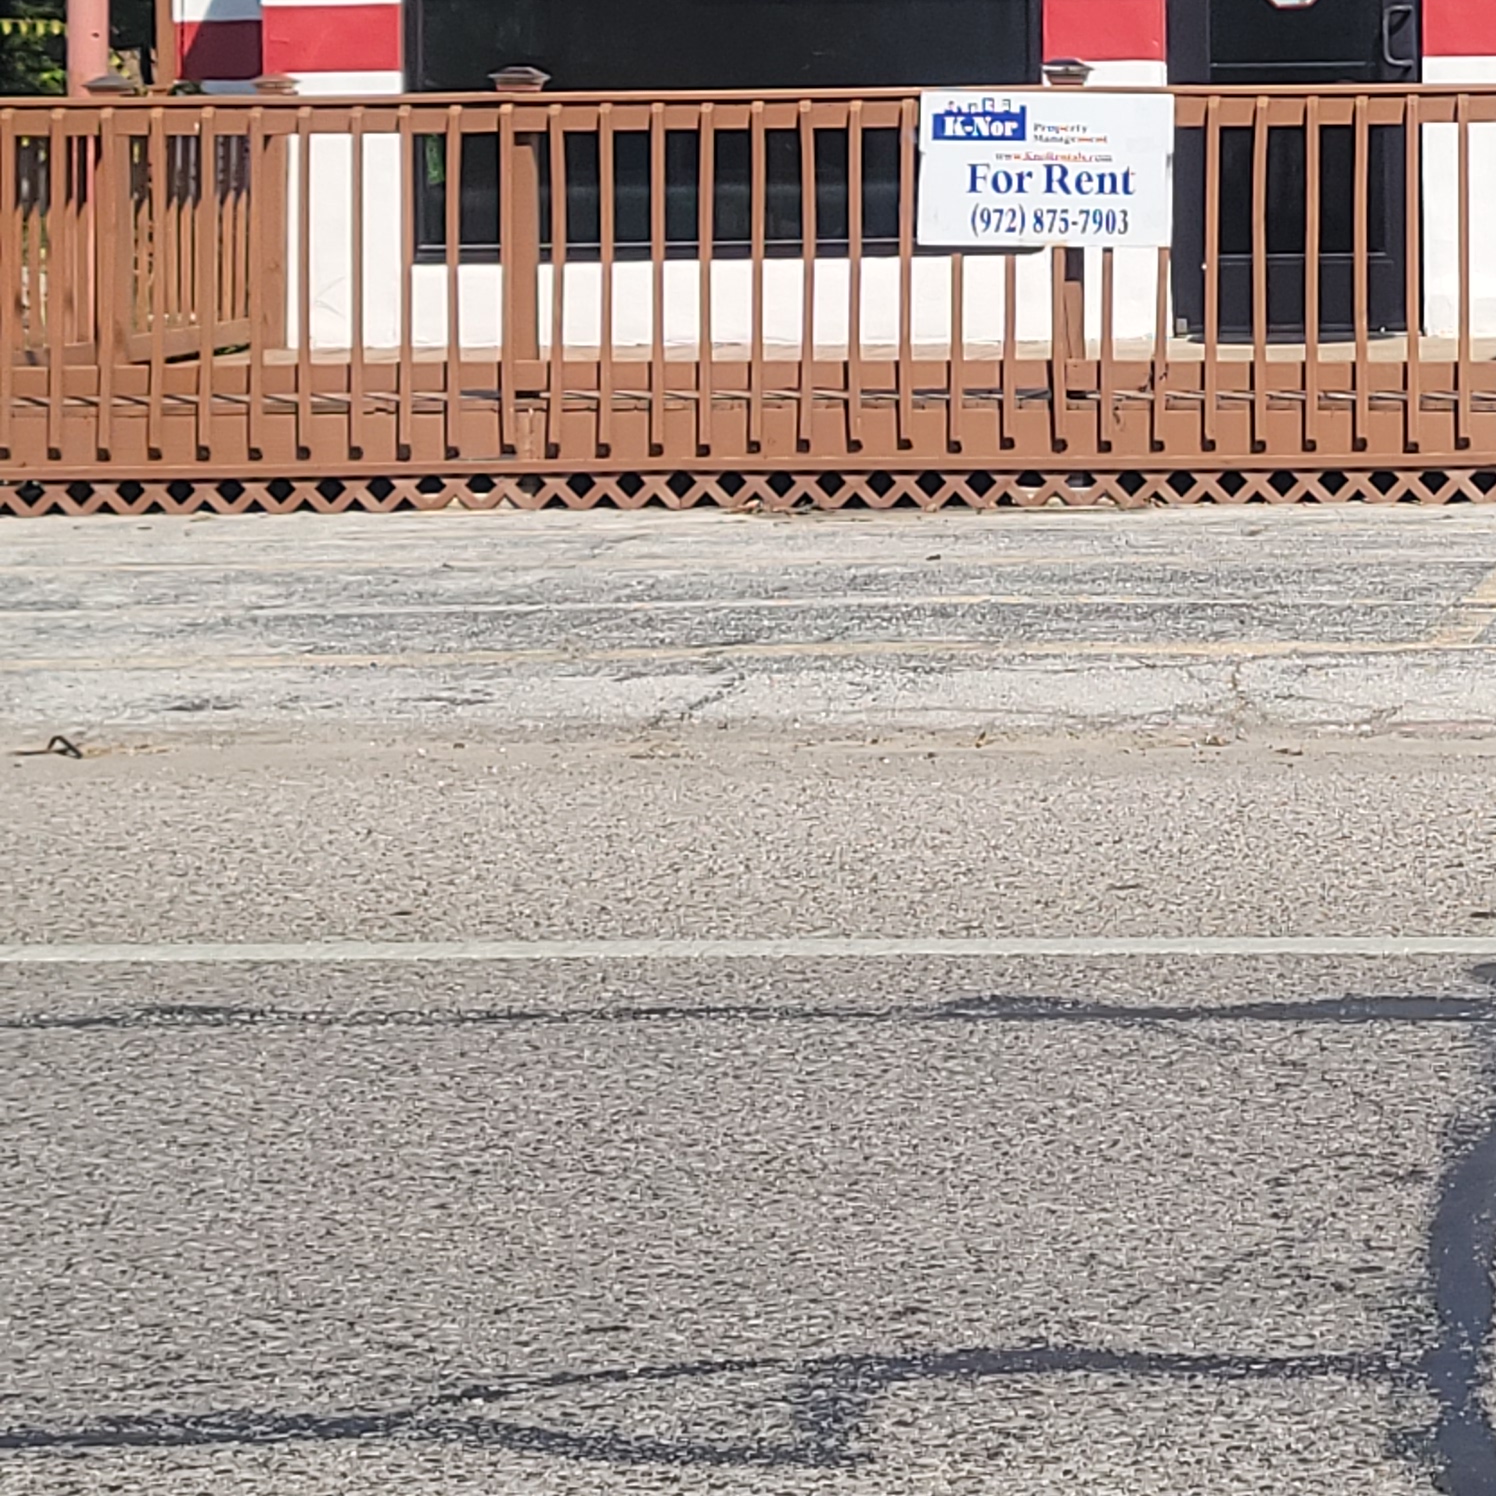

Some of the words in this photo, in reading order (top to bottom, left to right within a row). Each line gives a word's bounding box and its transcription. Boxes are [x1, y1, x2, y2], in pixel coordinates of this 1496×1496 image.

[943, 116, 1019, 137] K-Nor
[1033, 134, 1108, 144] Management
[967, 163, 1033, 194] For
[1043, 163, 1135, 195] Rent
[971, 203, 1026, 236] (972)
[1032, 207, 1129, 235] 875-7903
